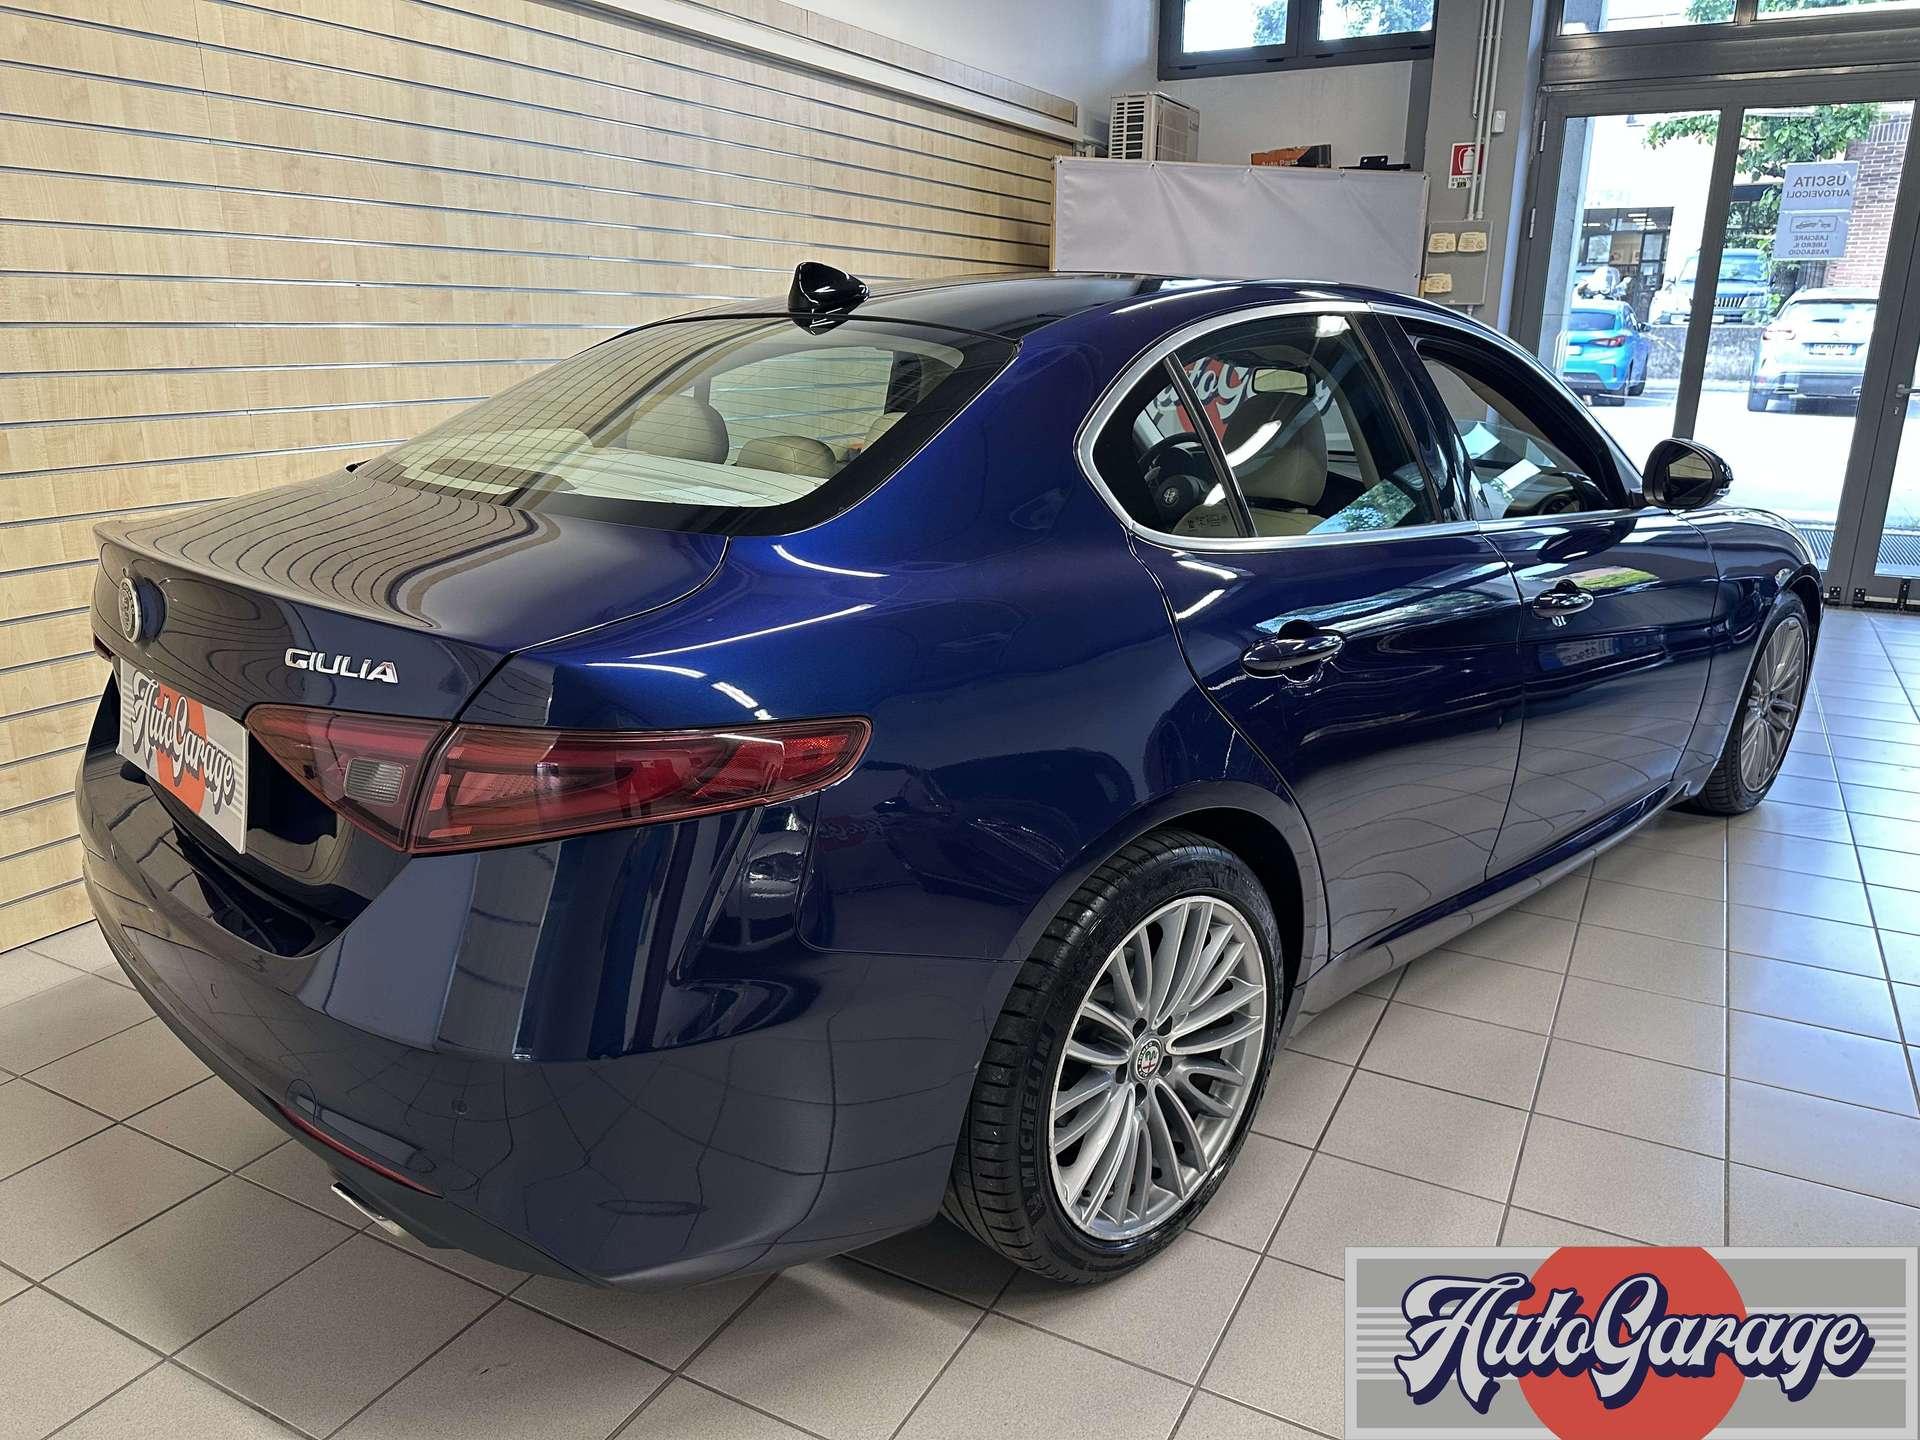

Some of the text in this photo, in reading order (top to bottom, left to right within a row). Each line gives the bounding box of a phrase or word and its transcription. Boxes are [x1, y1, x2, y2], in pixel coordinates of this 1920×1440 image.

[284, 647, 399, 684] GIULIA
[130, 671, 236, 815] AutoGarage
[1019, 1031, 1054, 1189] MICHELIN
